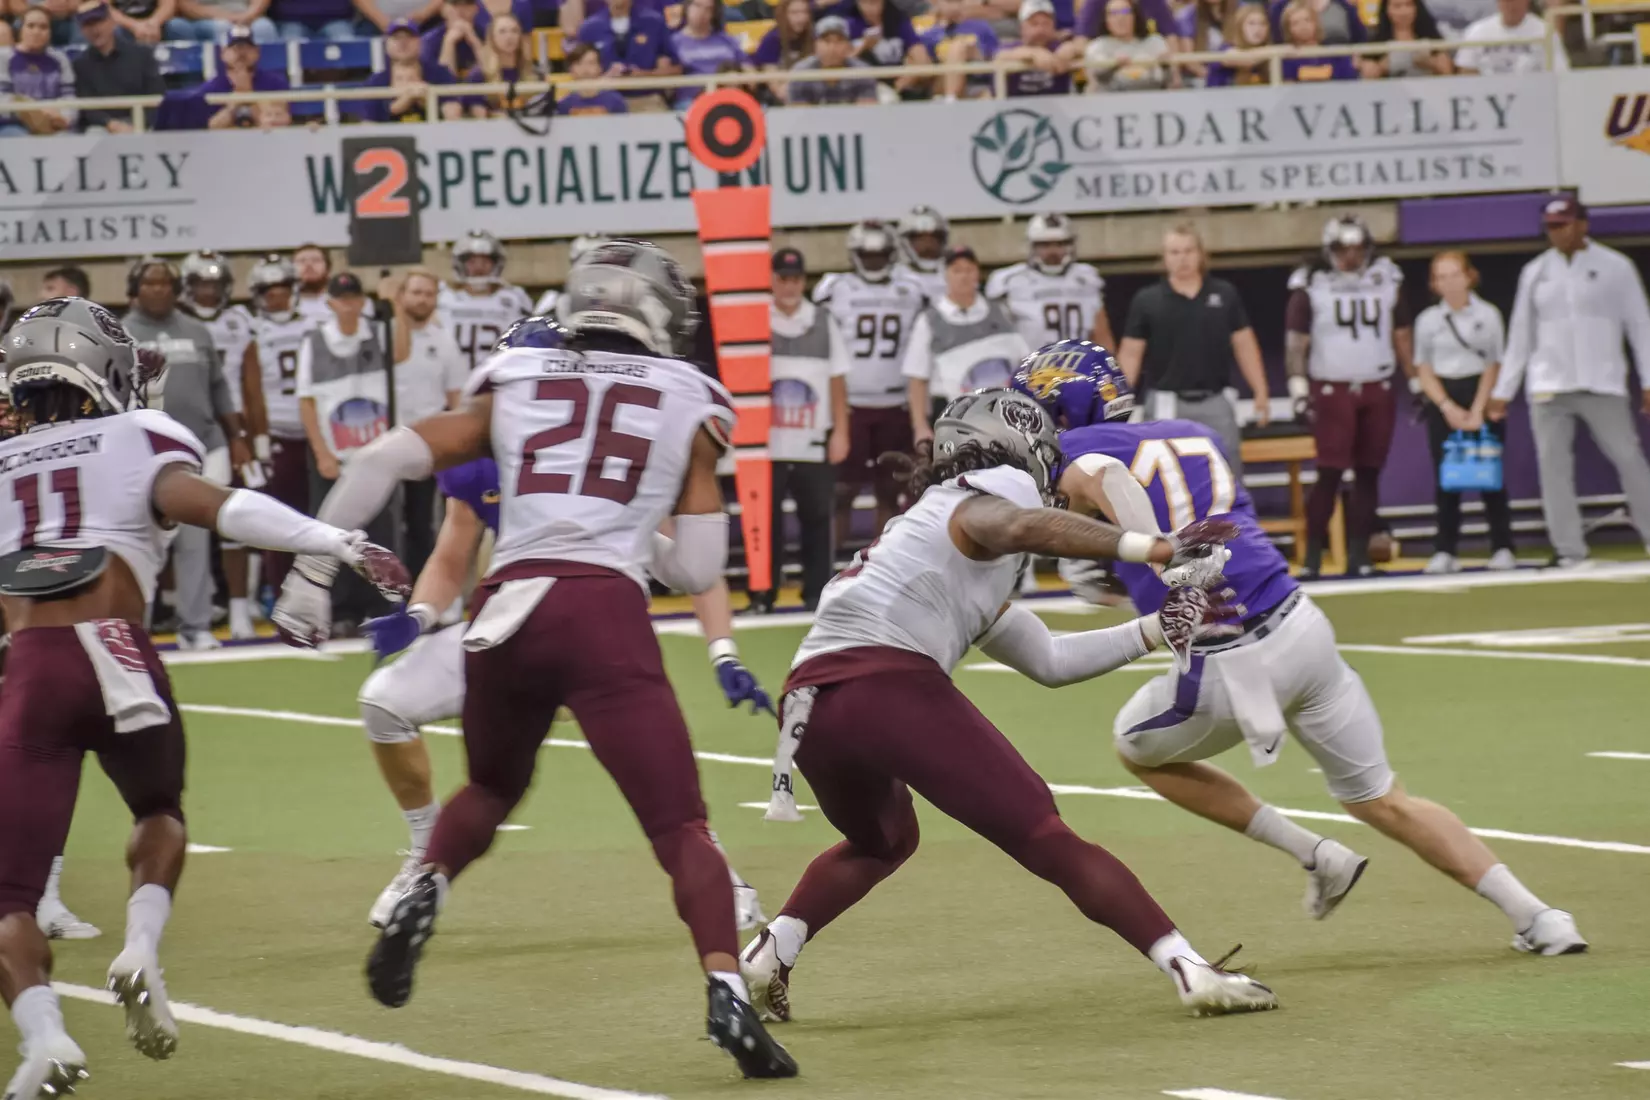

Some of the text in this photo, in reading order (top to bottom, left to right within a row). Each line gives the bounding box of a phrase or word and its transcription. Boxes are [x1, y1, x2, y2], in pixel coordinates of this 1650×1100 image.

[1070, 93, 1517, 151] CEDAR VALLEY
[1604, 93, 1650, 139] U
[306, 154, 350, 214] W
[783, 133, 865, 195] UNI
[354, 147, 412, 219] 2
[1075, 168, 1246, 199] MEDICAL
[1259, 153, 1496, 189] SPECIALISTS
[853, 313, 902, 359] 99
[1043, 302, 1083, 340] 90
[1334, 298, 1382, 340] 44
[514, 377, 665, 506] 26
[12, 466, 82, 549] 11
[1129, 436, 1236, 533] 17
